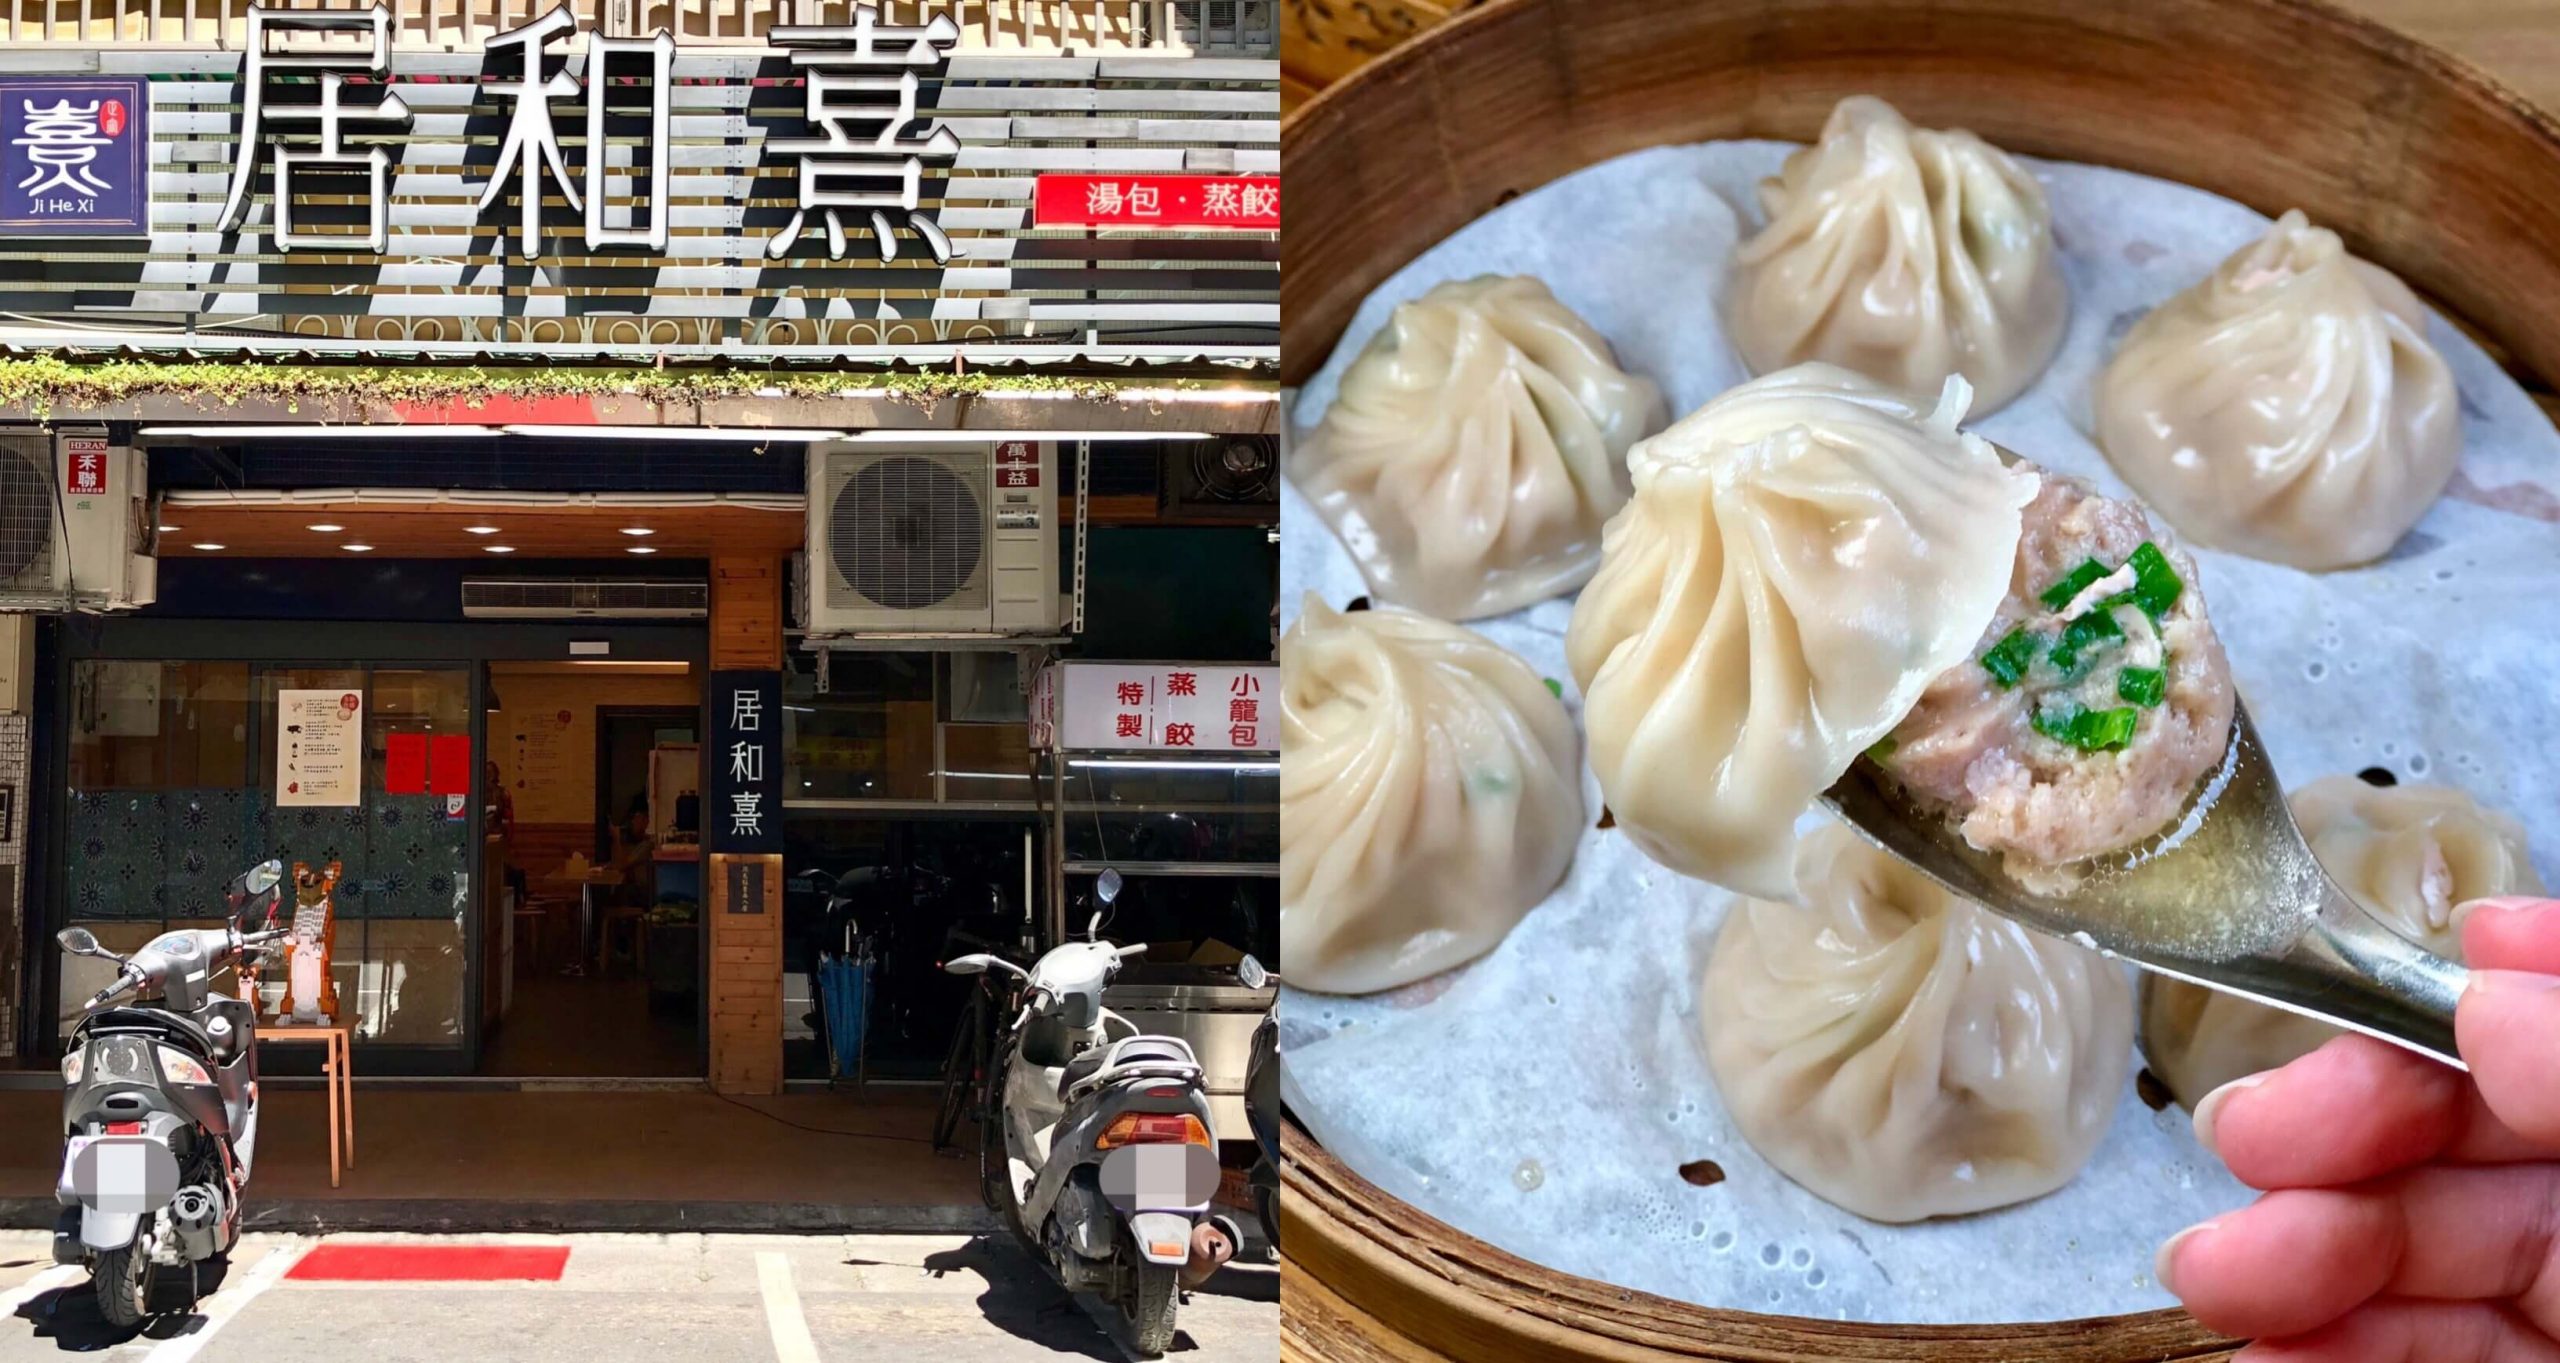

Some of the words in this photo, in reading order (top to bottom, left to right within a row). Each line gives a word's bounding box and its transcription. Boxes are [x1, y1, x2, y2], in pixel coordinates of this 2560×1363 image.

[216, 1, 961, 265] 居和熹
[29, 198, 44, 214] Ji
[50, 199, 74, 213] He
[77, 199, 94, 213] Xi
[70, 441, 106, 450] HERAN
[78, 455, 97, 488] 禾聯
[1007, 442, 1028, 485] 萬士益
[1116, 681, 1144, 738] 特製
[1165, 672, 1197, 746] 蒸餃
[1228, 673, 1260, 747] 小籠包
[730, 689, 763, 837] 居和熹
